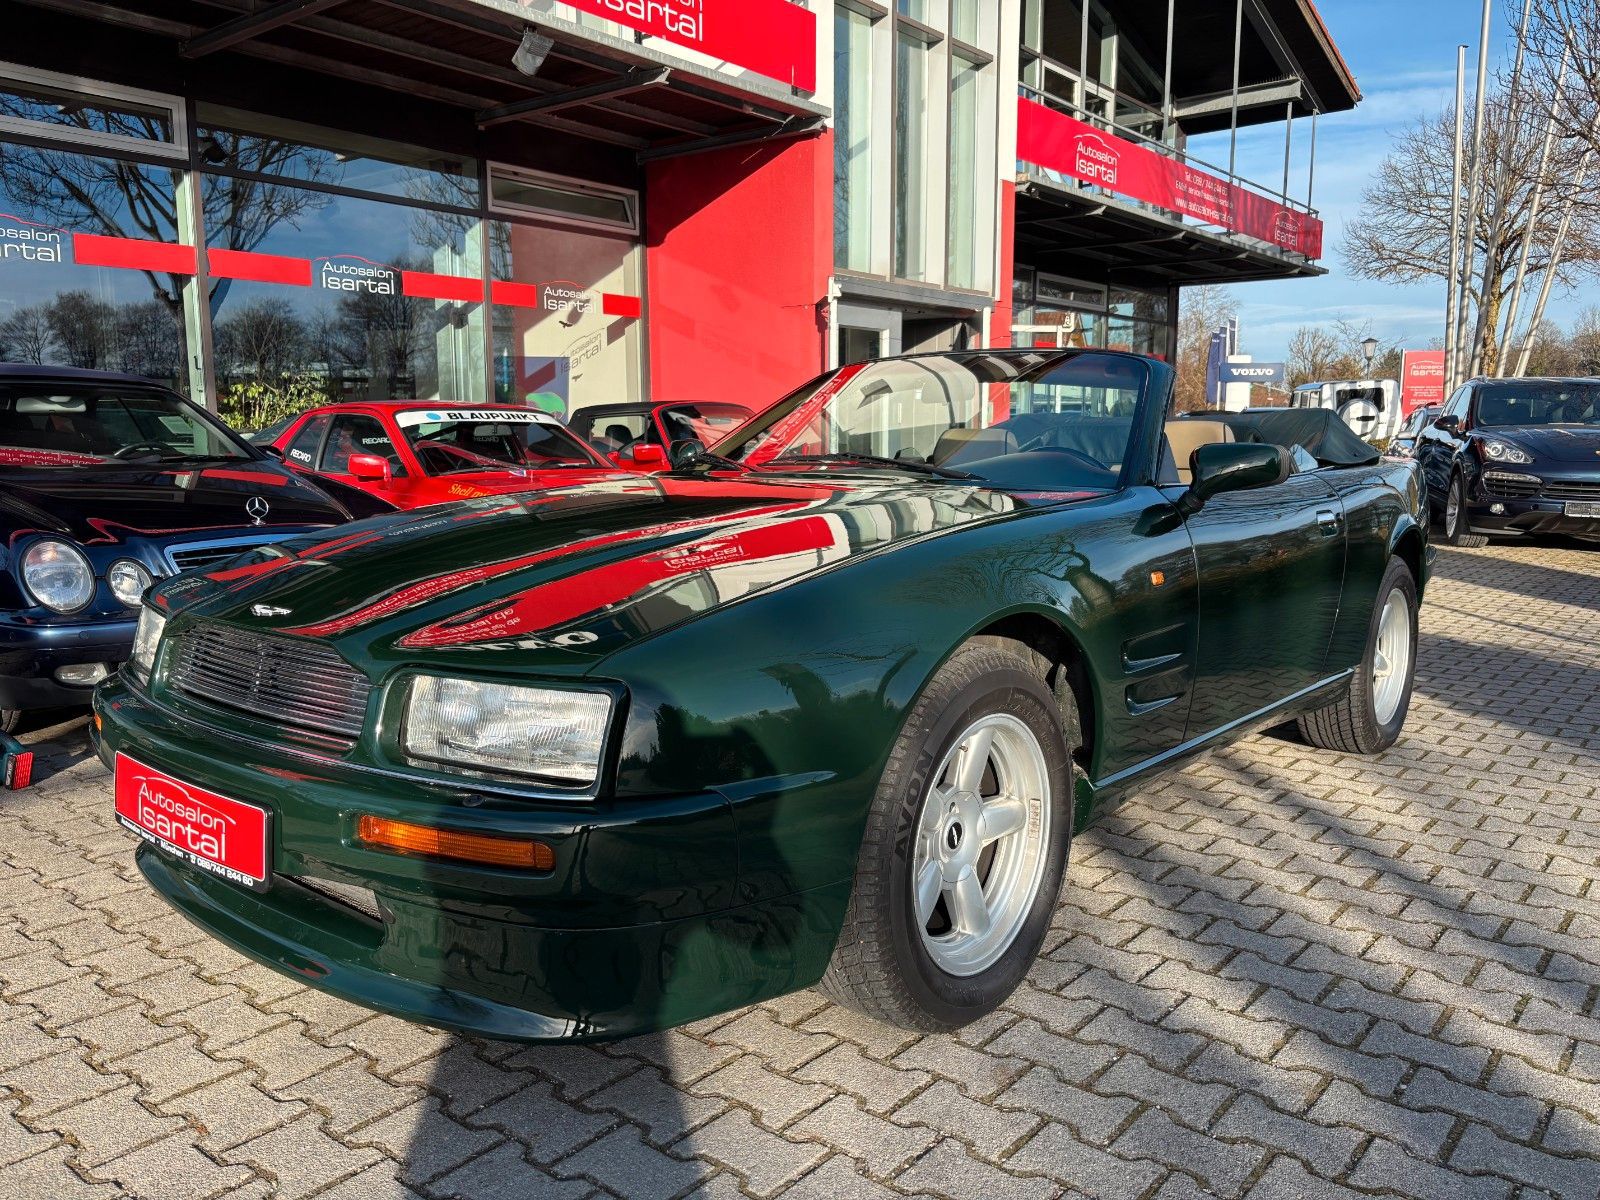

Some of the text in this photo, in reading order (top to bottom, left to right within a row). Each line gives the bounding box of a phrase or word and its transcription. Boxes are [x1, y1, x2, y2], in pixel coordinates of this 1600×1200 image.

[1077, 141, 1118, 166] Autosalon
[1076, 152, 1117, 184] Isartal
[322, 261, 394, 279] Autosalon
[322, 272, 394, 295] Isartal
[1231, 368, 1274, 376] VOLVO
[446, 412, 540, 421] BLAUPUNKT
[290, 448, 312, 463] RECARO
[448, 483, 475, 497] Shell
[138, 782, 226, 834] Autosalon
[894, 747, 934, 863] AVON
[138, 795, 226, 862] Isartal
[160, 840, 184, 858] München
[227, 869, 242, 882] 244
[242, 875, 254, 887] 60
